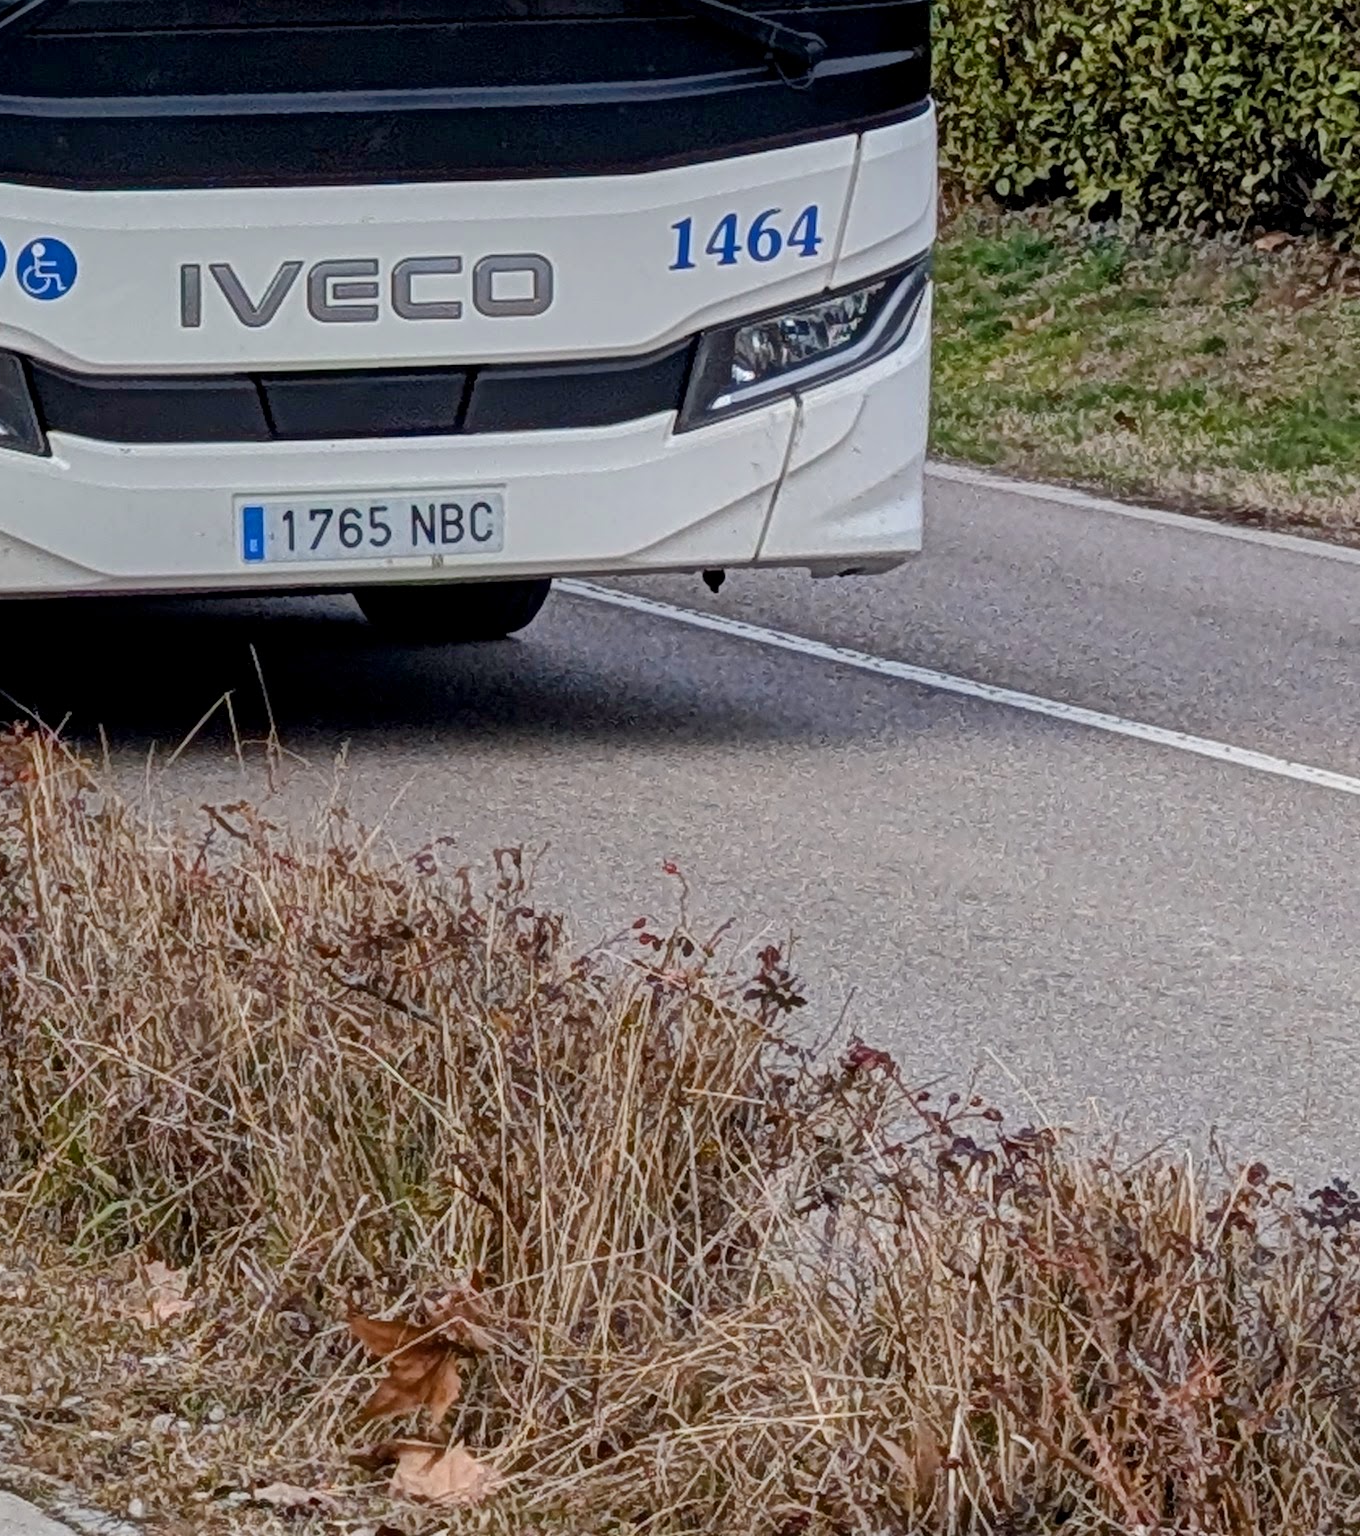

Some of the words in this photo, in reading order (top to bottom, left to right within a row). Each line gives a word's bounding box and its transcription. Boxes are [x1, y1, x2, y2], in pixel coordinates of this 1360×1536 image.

[669, 204, 823, 271] 1464
[180, 253, 554, 328] IVECO
[281, 505, 392, 552] 1765
[410, 501, 494, 547] NBC
